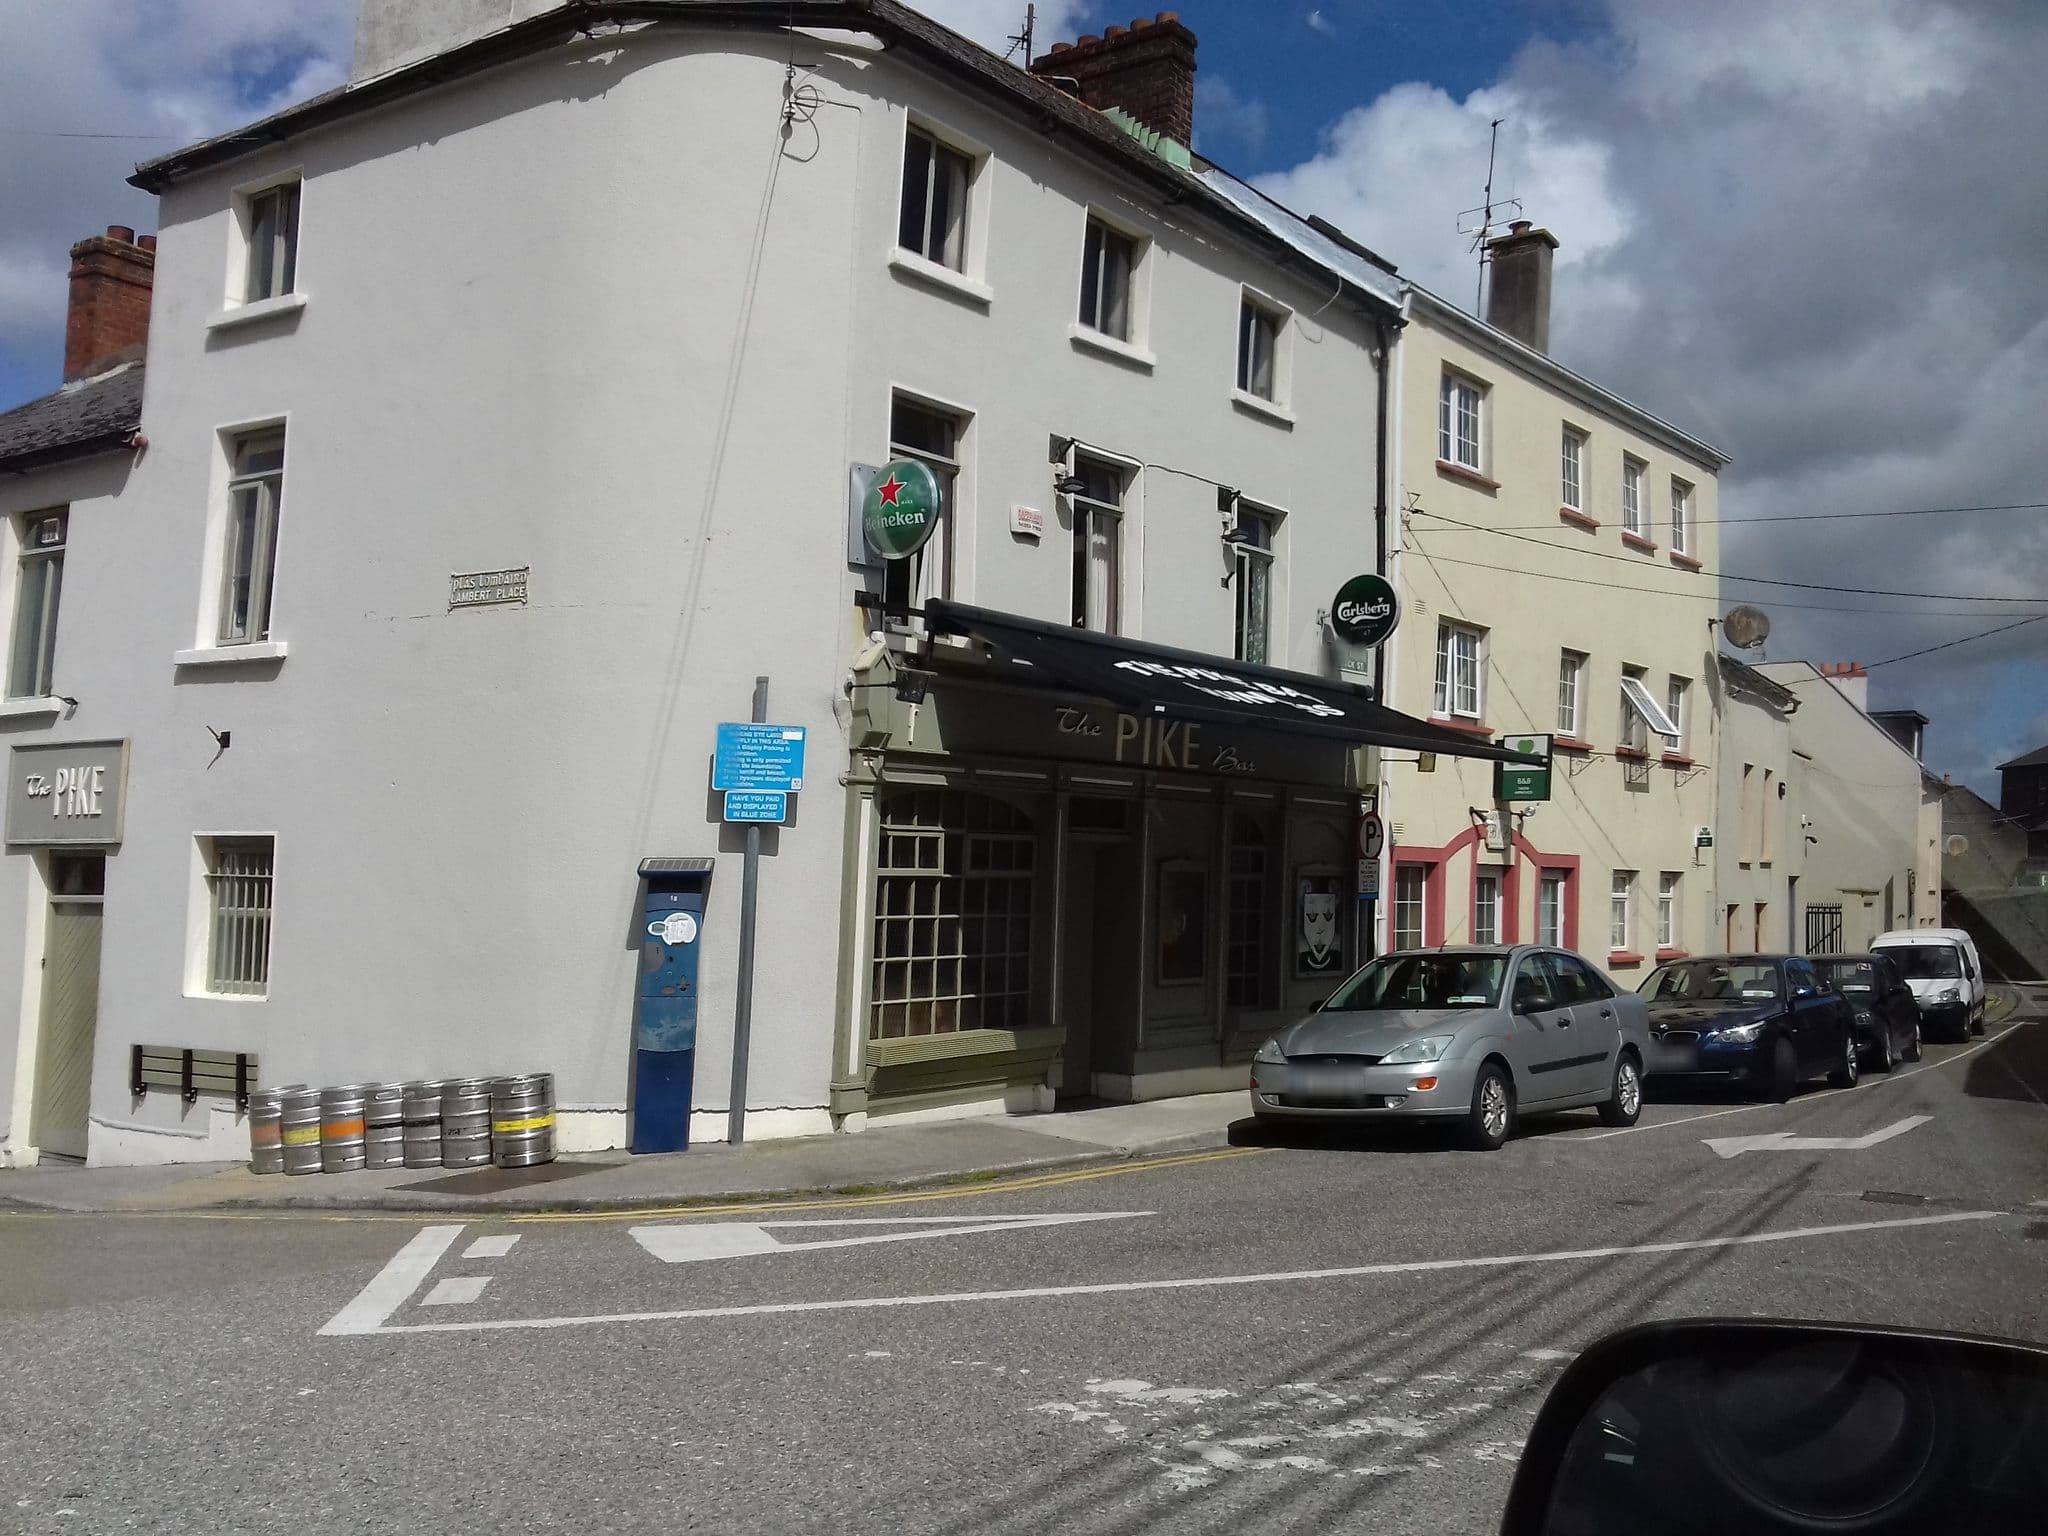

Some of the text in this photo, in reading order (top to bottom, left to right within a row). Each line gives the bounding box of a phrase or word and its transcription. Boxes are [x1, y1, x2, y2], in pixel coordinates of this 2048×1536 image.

[865, 511, 926, 532] Heineken
[451, 586, 526, 603] LAMBERT PLACE
[1337, 600, 1390, 622] Carlsberg
[1056, 706, 1256, 773] The PIKE Bar
[26, 766, 104, 816] The PIKE
[1365, 820, 1377, 853] P
